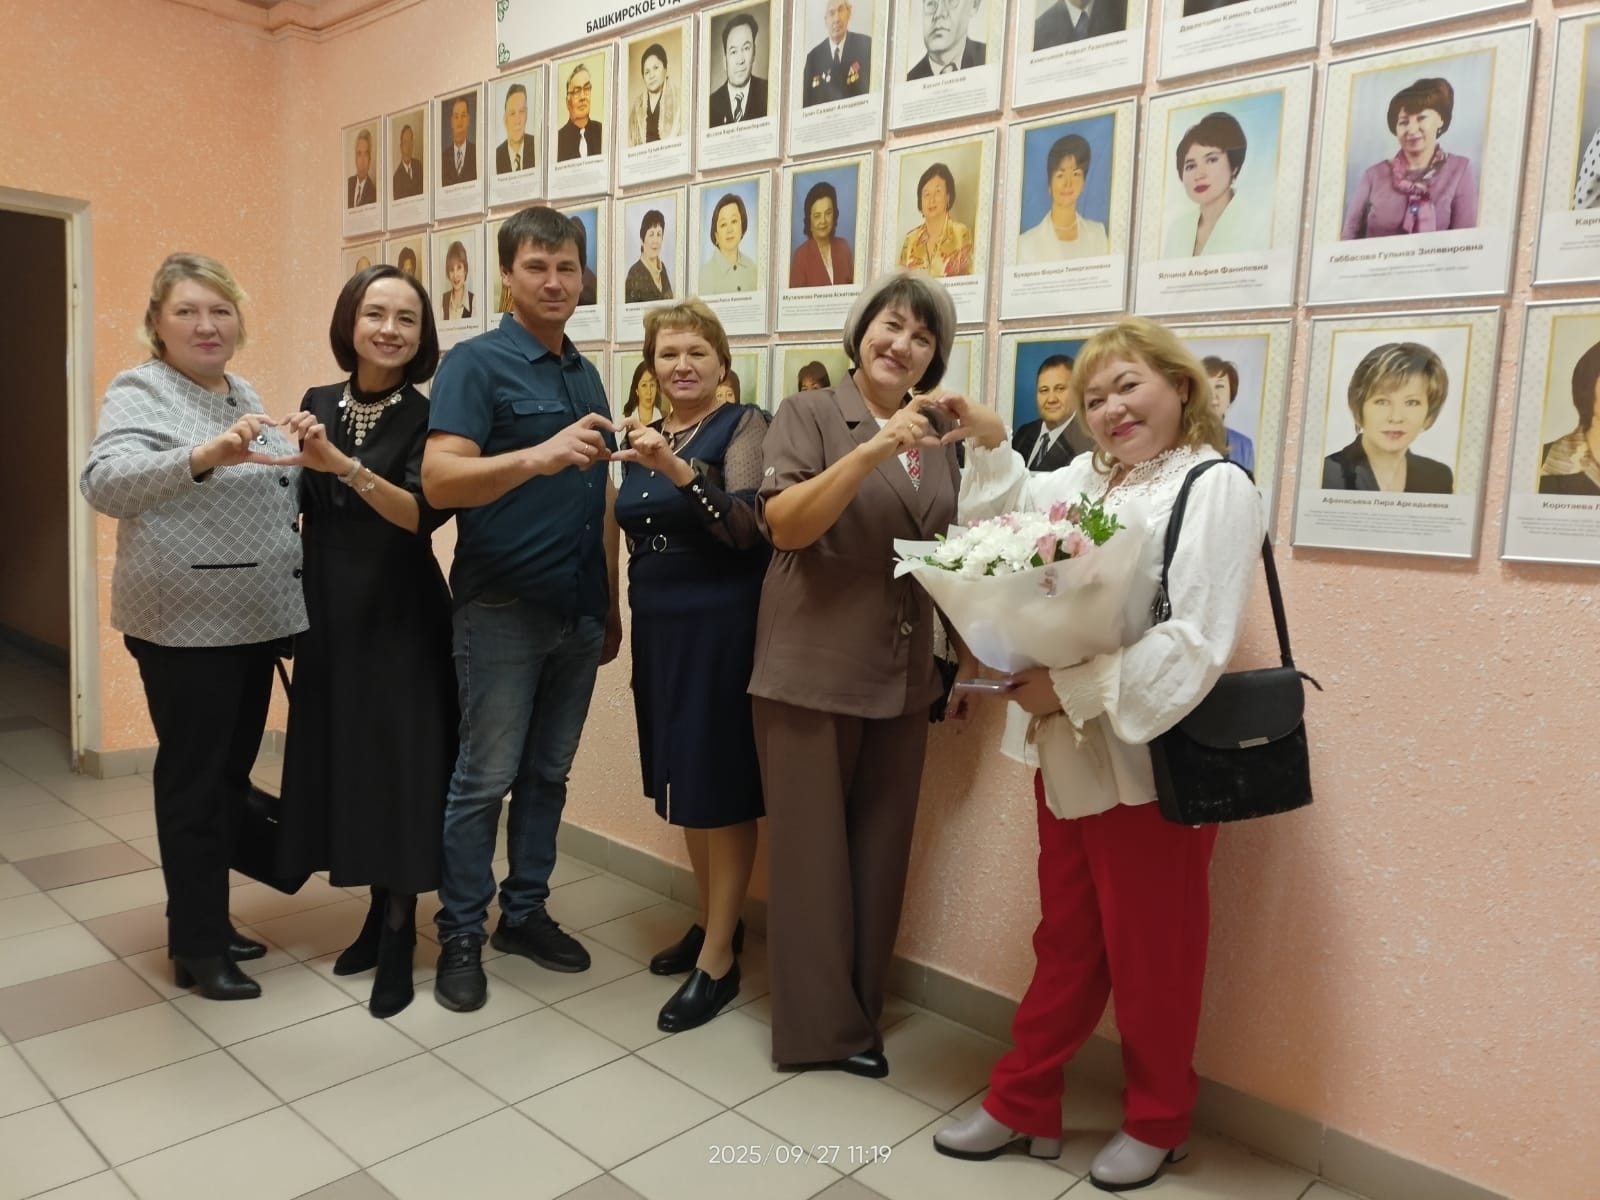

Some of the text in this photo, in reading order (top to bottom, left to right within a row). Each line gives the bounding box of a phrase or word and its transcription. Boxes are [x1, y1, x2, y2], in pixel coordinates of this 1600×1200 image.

[586, 0, 656, 33] БАШКИРСКОЕ
[1378, 250, 1415, 261] Гульназ
[1188, 268, 1219, 278] Альфия
